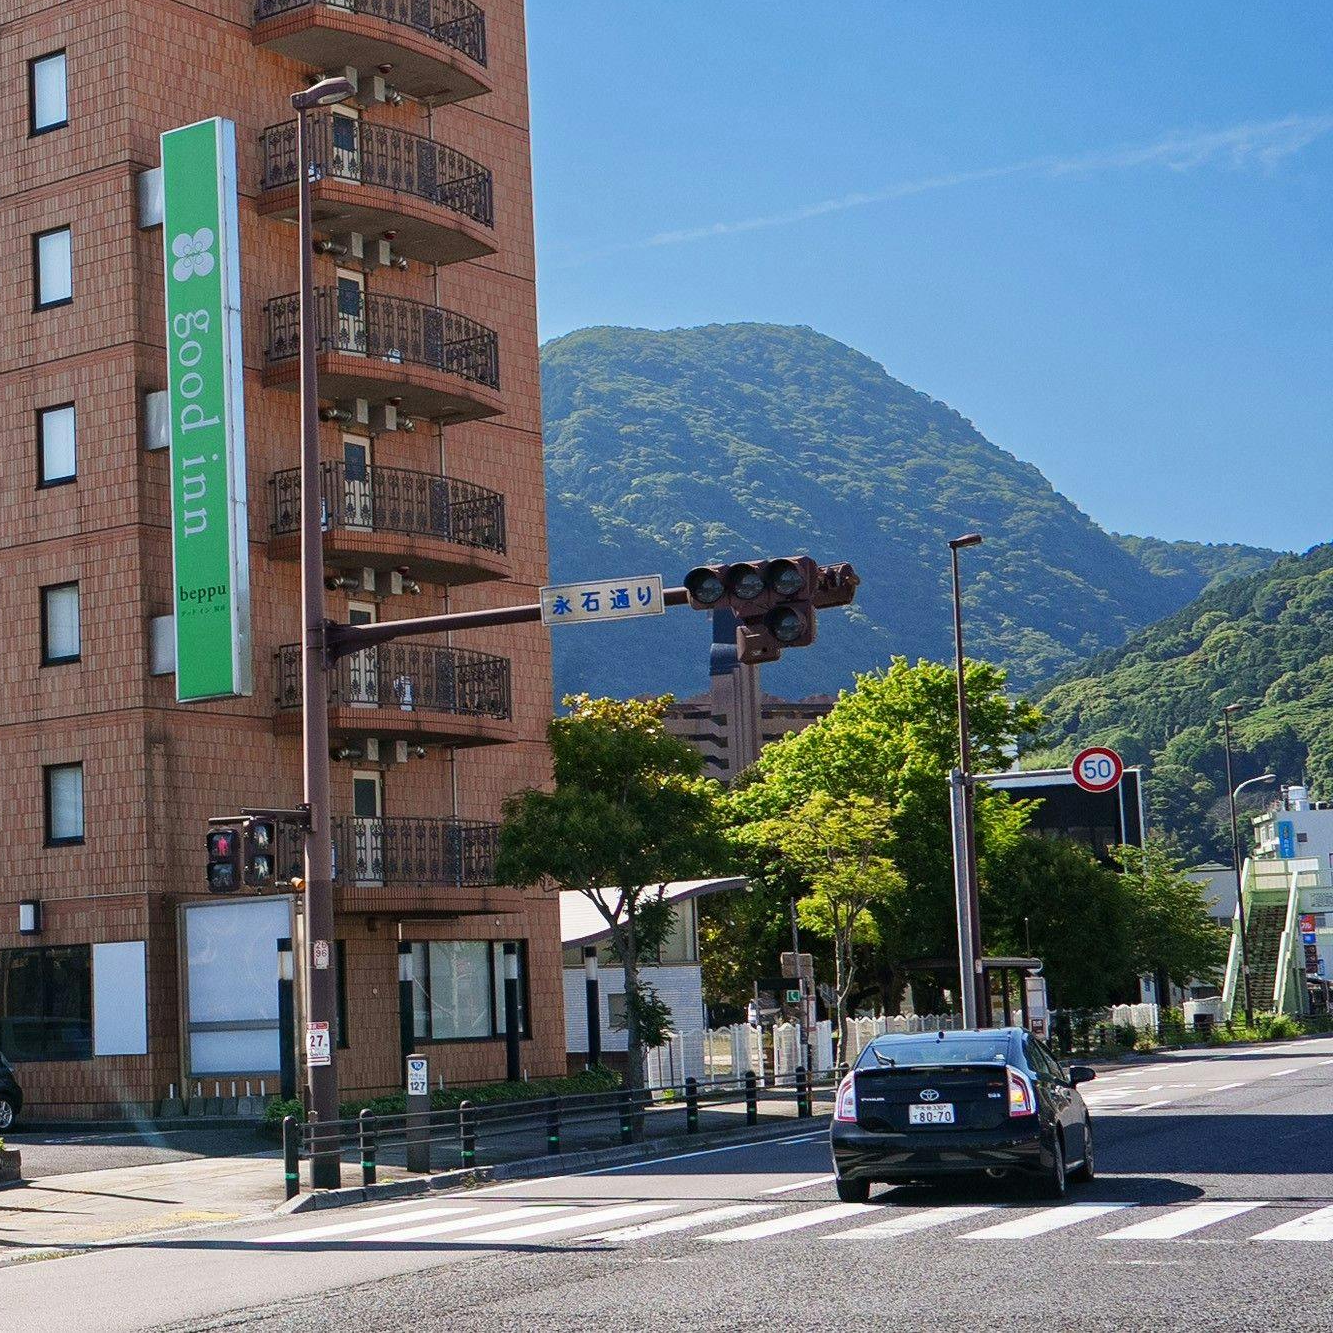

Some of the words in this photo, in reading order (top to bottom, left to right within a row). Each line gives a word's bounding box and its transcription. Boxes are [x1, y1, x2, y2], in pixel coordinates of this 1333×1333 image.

[173, 309, 220, 435] good
[182, 452, 220, 538] inn
[179, 584, 226, 604] beppu
[552, 585, 652, 615] 永石通り
[1084, 759, 1111, 779] 50
[410, 1082, 425, 1091] 127
[919, 1111, 952, 1122] 80-70
